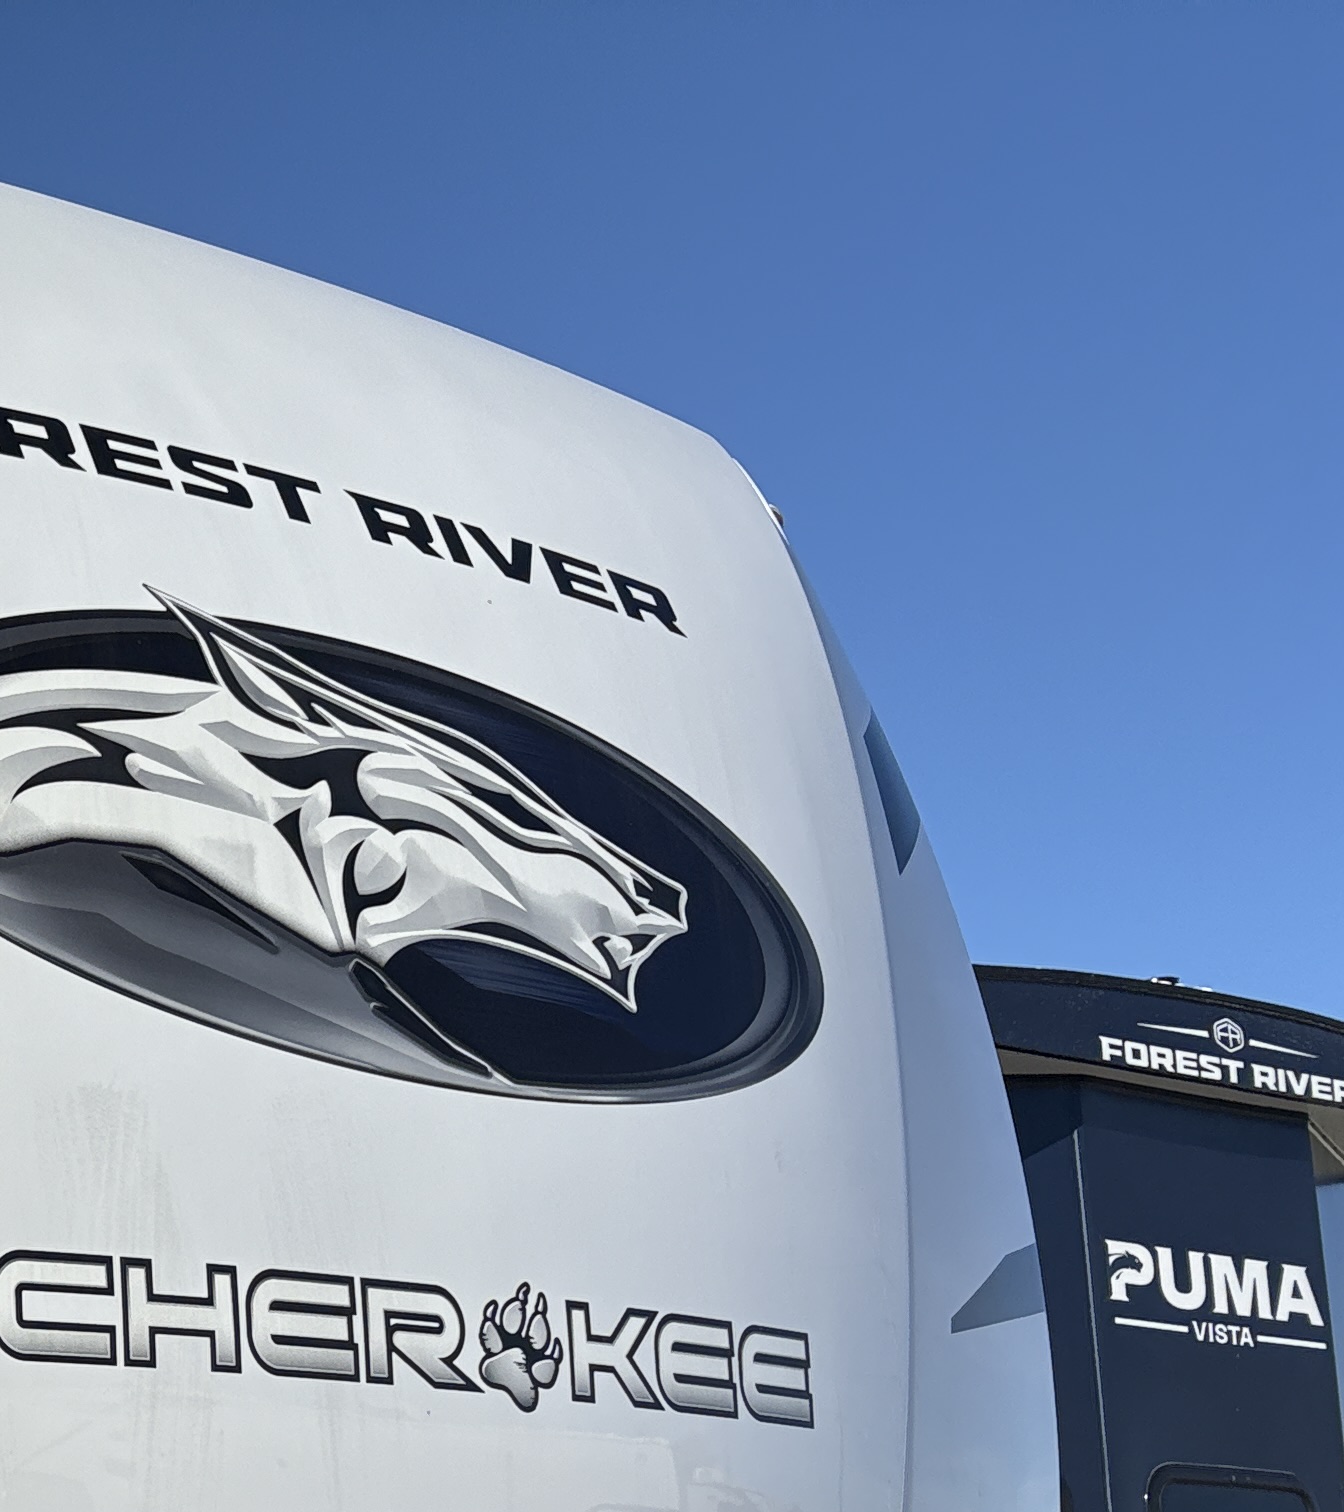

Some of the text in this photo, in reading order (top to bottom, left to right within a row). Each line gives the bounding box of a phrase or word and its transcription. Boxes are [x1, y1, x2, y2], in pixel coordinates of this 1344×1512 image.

[344, 489, 688, 638] RIVER
[1098, 1035, 1245, 1085] FOREST
[1105, 1238, 1325, 1327] PUMA
[1192, 1320, 1255, 1348] VISTA
